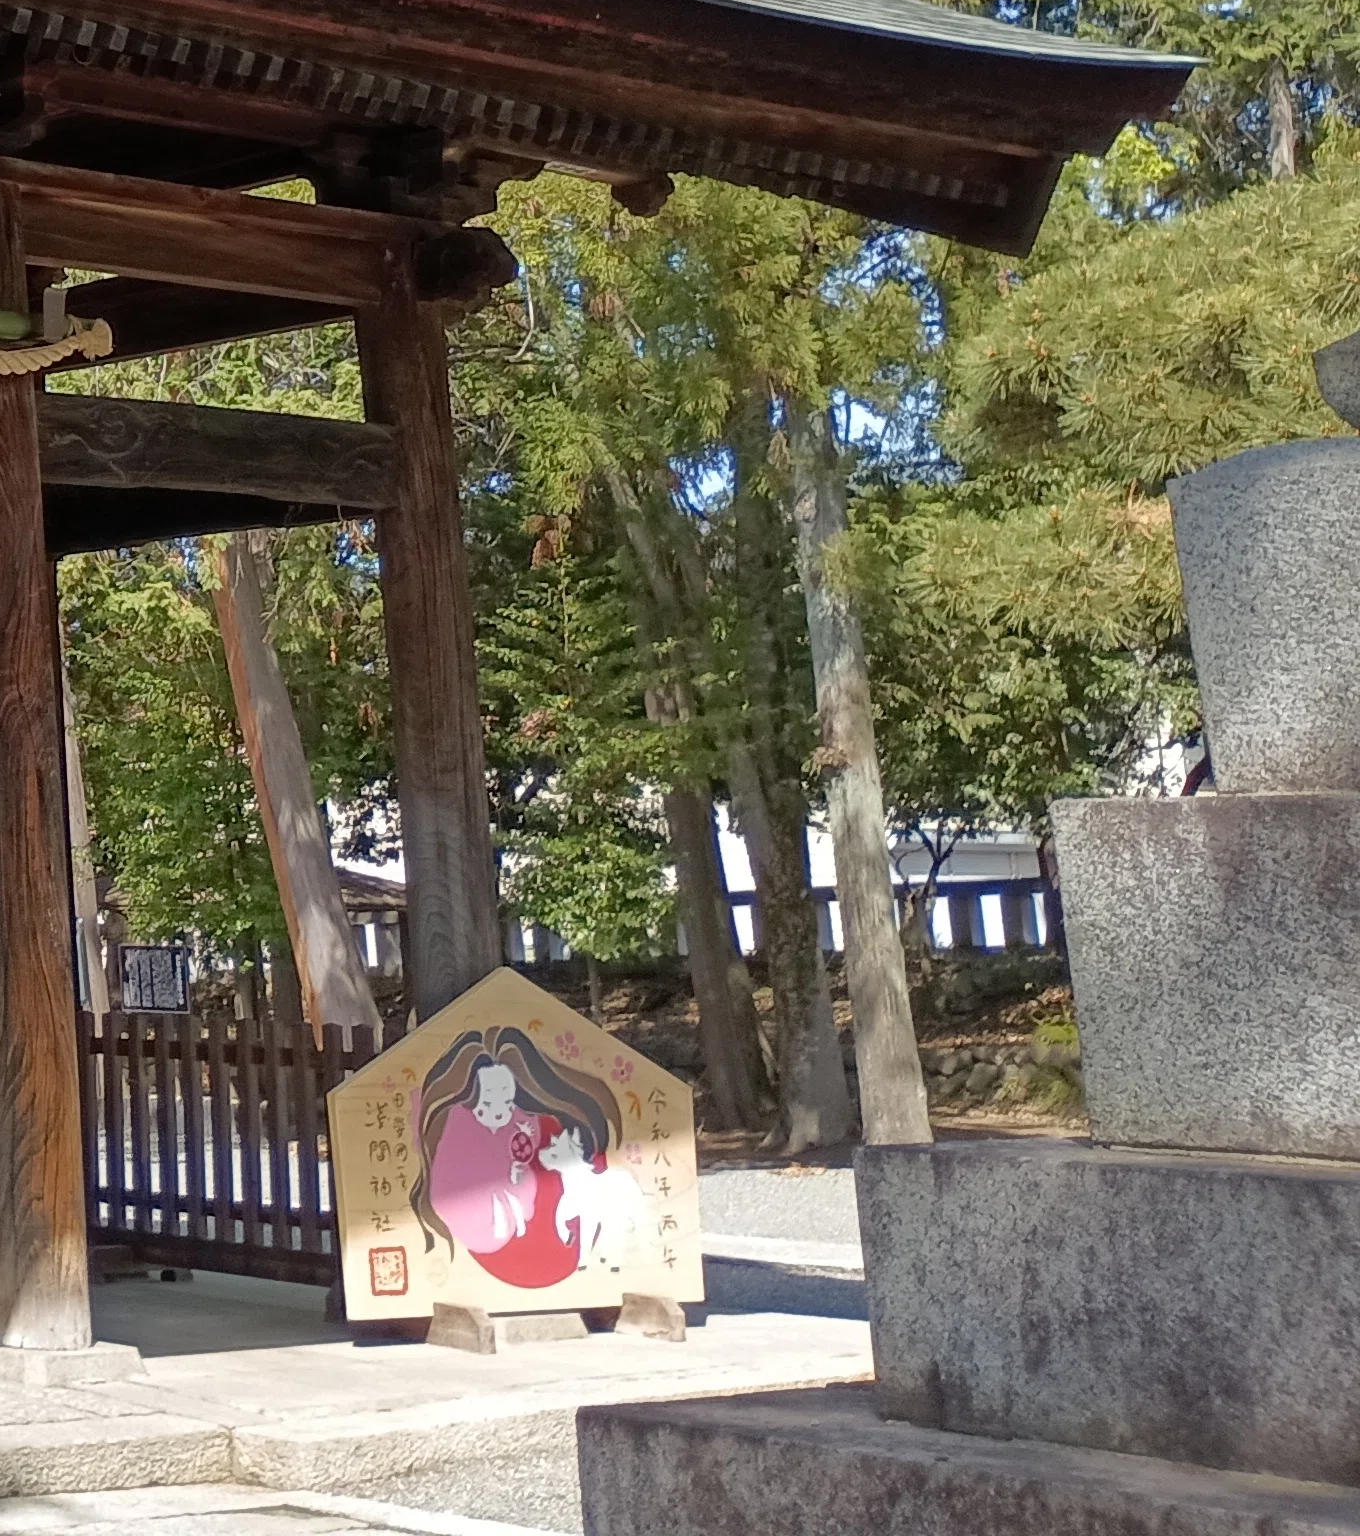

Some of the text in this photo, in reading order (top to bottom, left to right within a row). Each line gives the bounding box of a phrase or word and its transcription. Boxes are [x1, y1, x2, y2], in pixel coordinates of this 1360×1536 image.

[647, 1086, 678, 1269] 令和八年丙午
